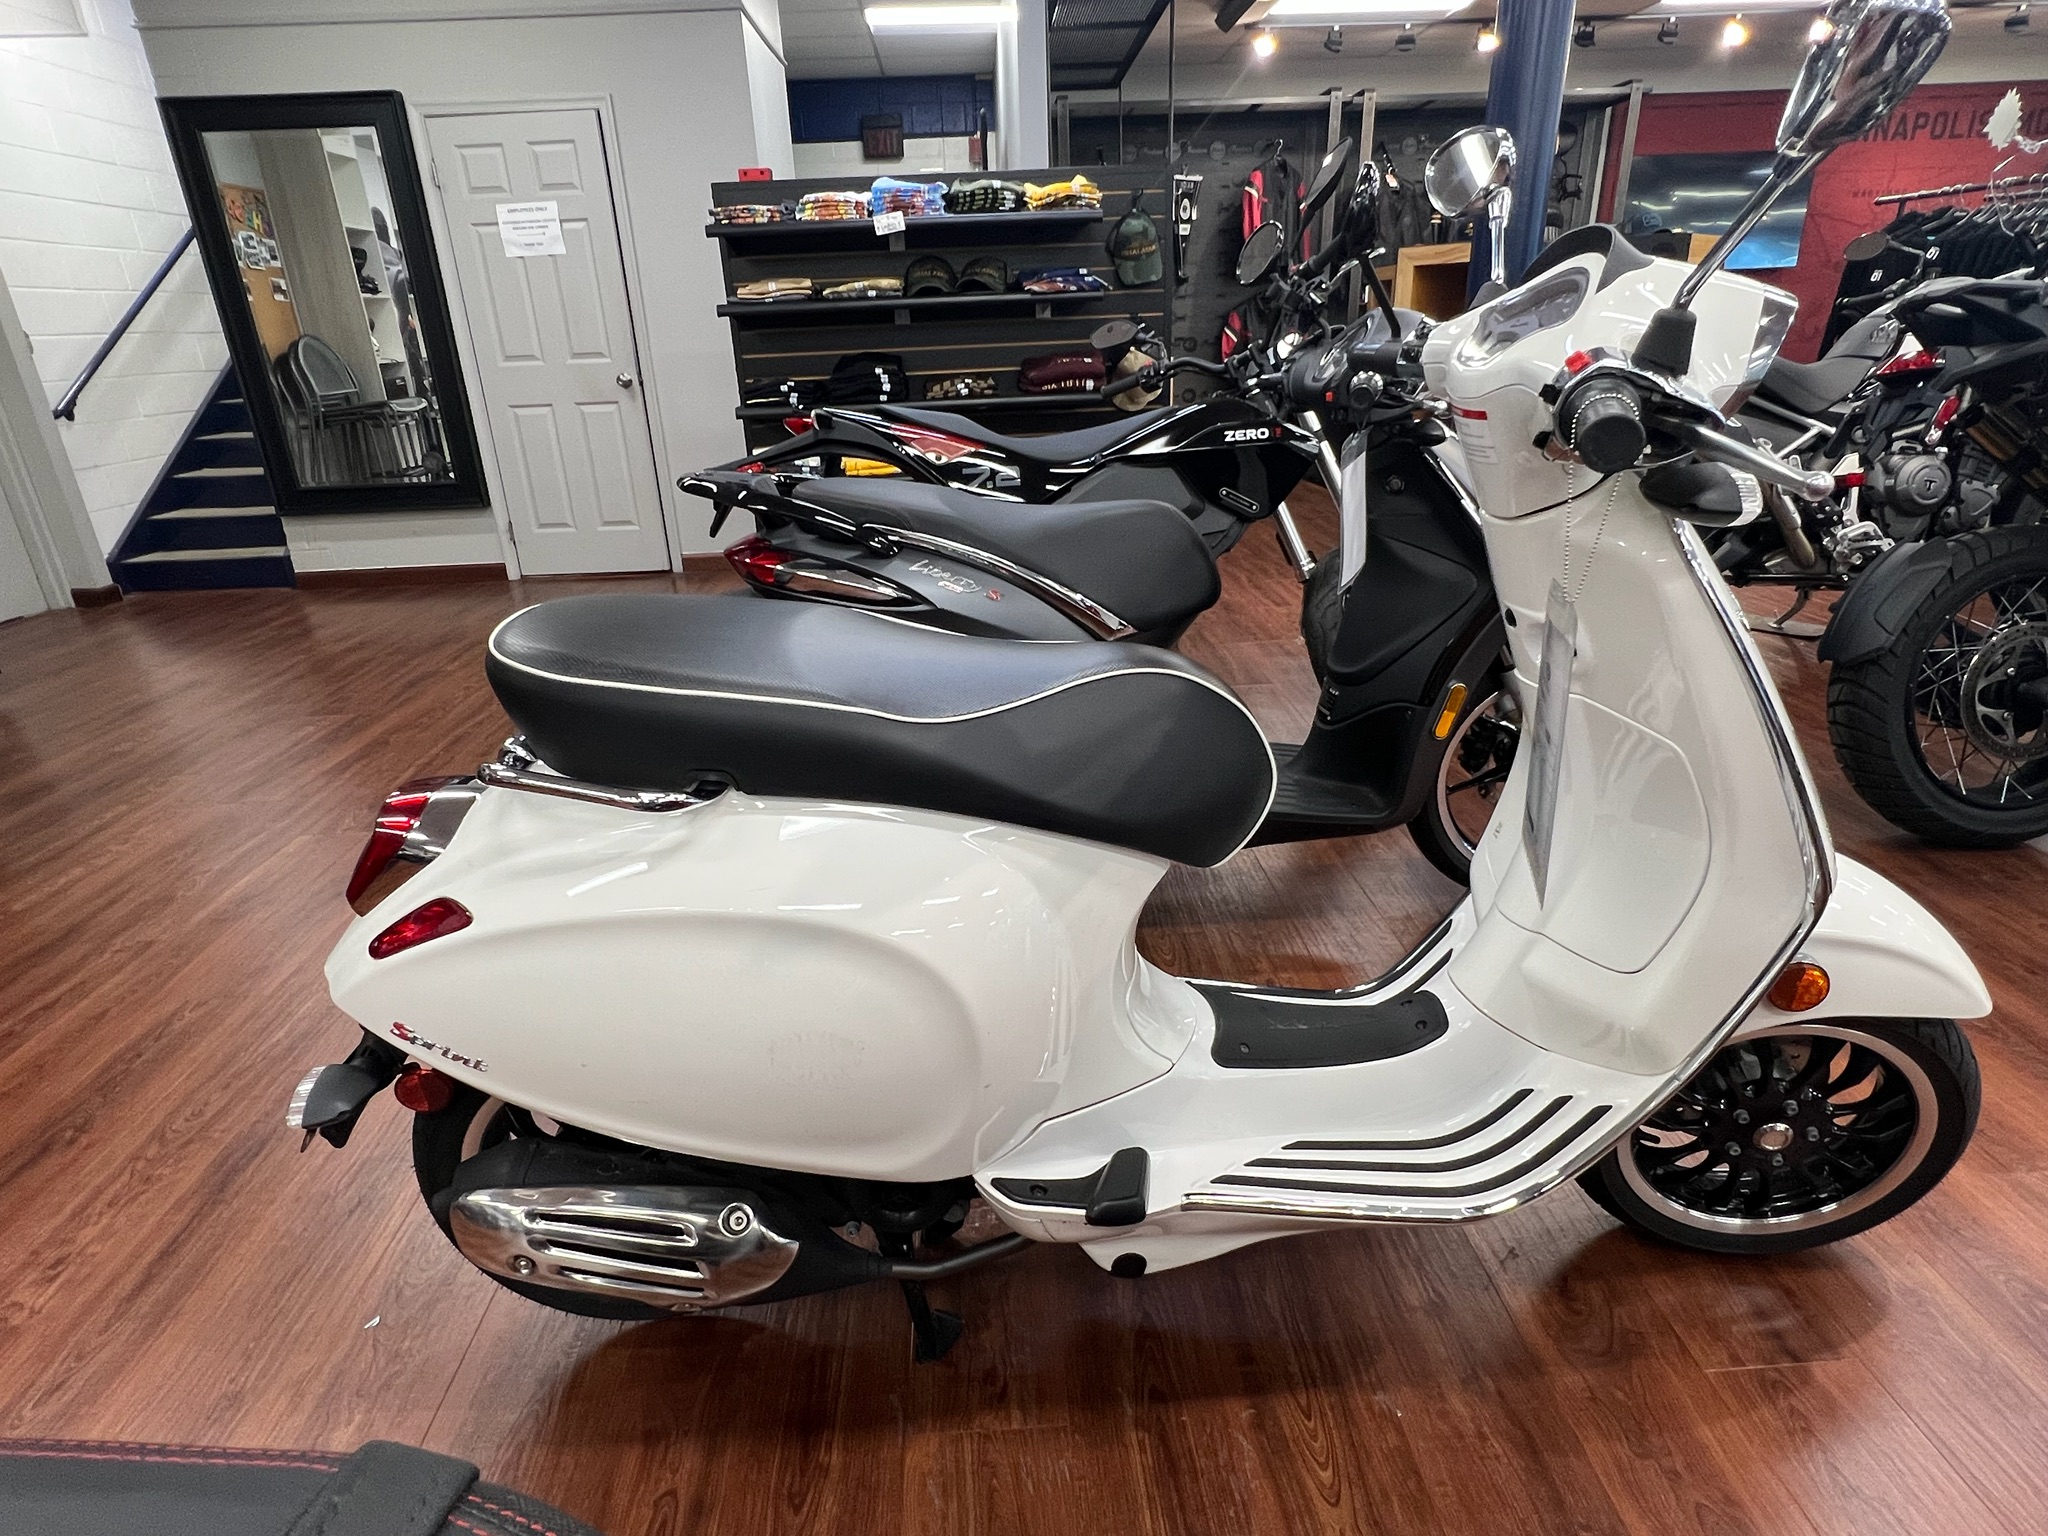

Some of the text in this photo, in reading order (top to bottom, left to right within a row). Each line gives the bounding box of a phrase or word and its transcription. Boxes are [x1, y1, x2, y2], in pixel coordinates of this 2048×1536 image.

[1224, 428, 1270, 442] ZERO
[962, 466, 1021, 489] 7.2
[389, 1021, 489, 1073] Sprint
